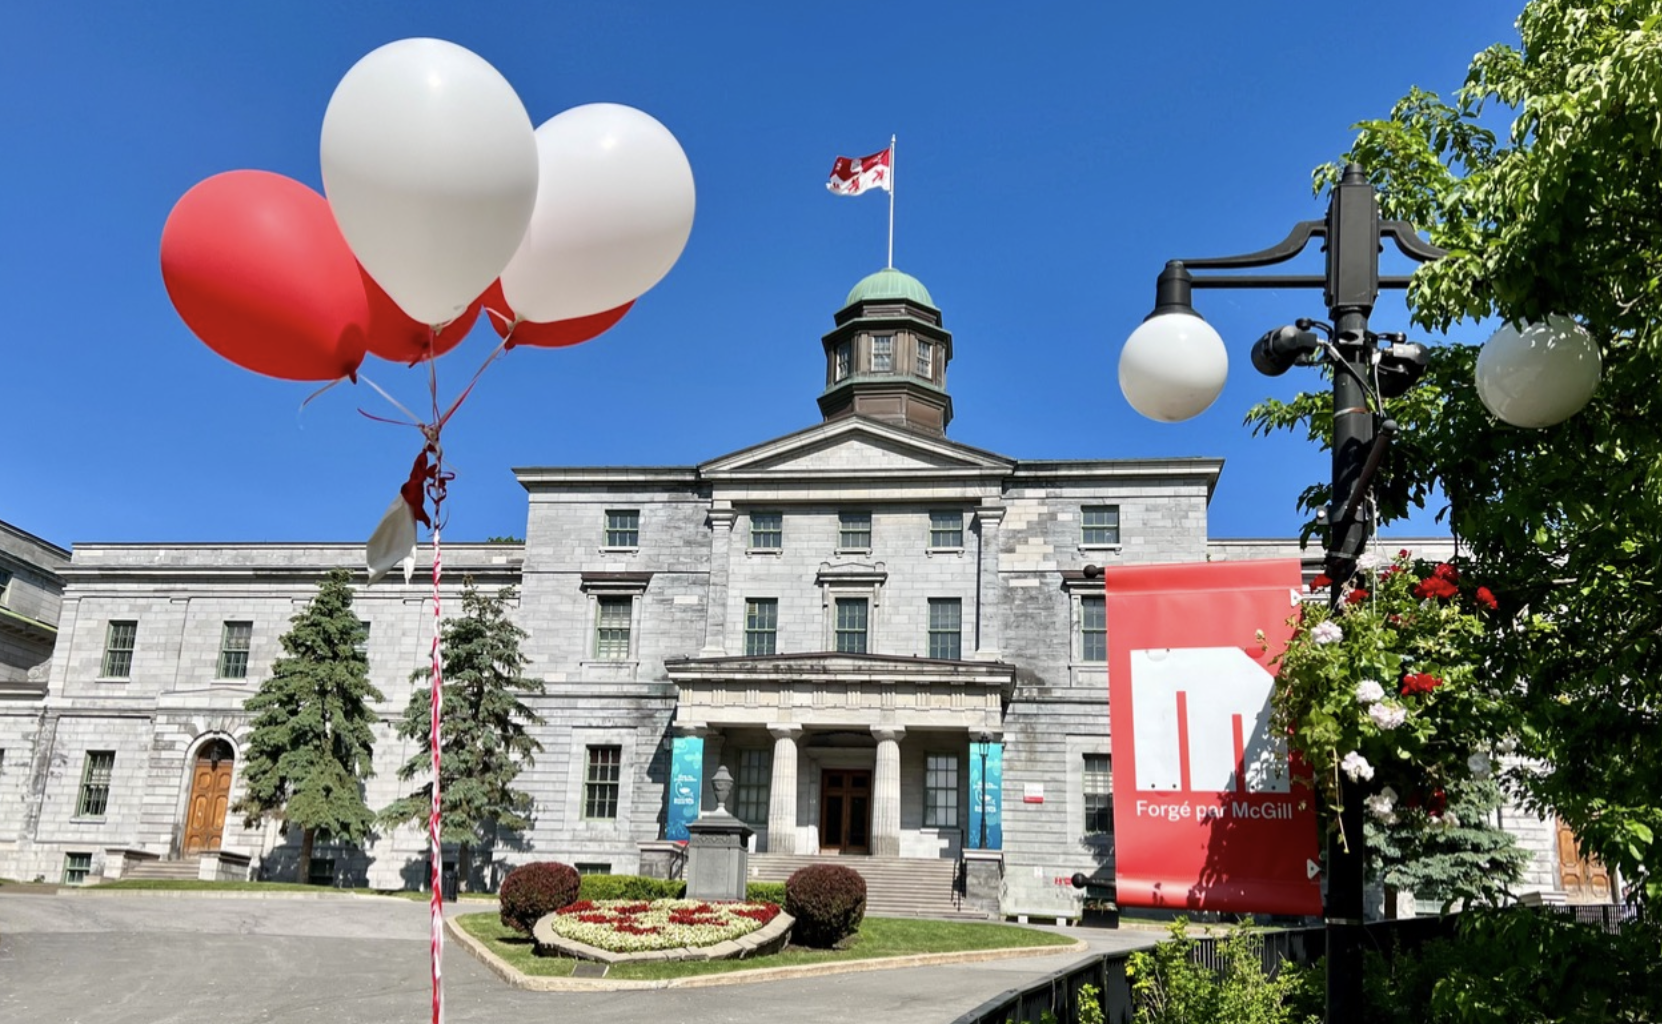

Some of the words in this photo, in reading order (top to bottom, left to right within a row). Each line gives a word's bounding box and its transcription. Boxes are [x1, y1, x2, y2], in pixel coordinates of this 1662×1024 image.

[1136, 800, 1191, 822] Forgé
[1196, 804, 1226, 820] par
[1231, 801, 1293, 820] McGill
